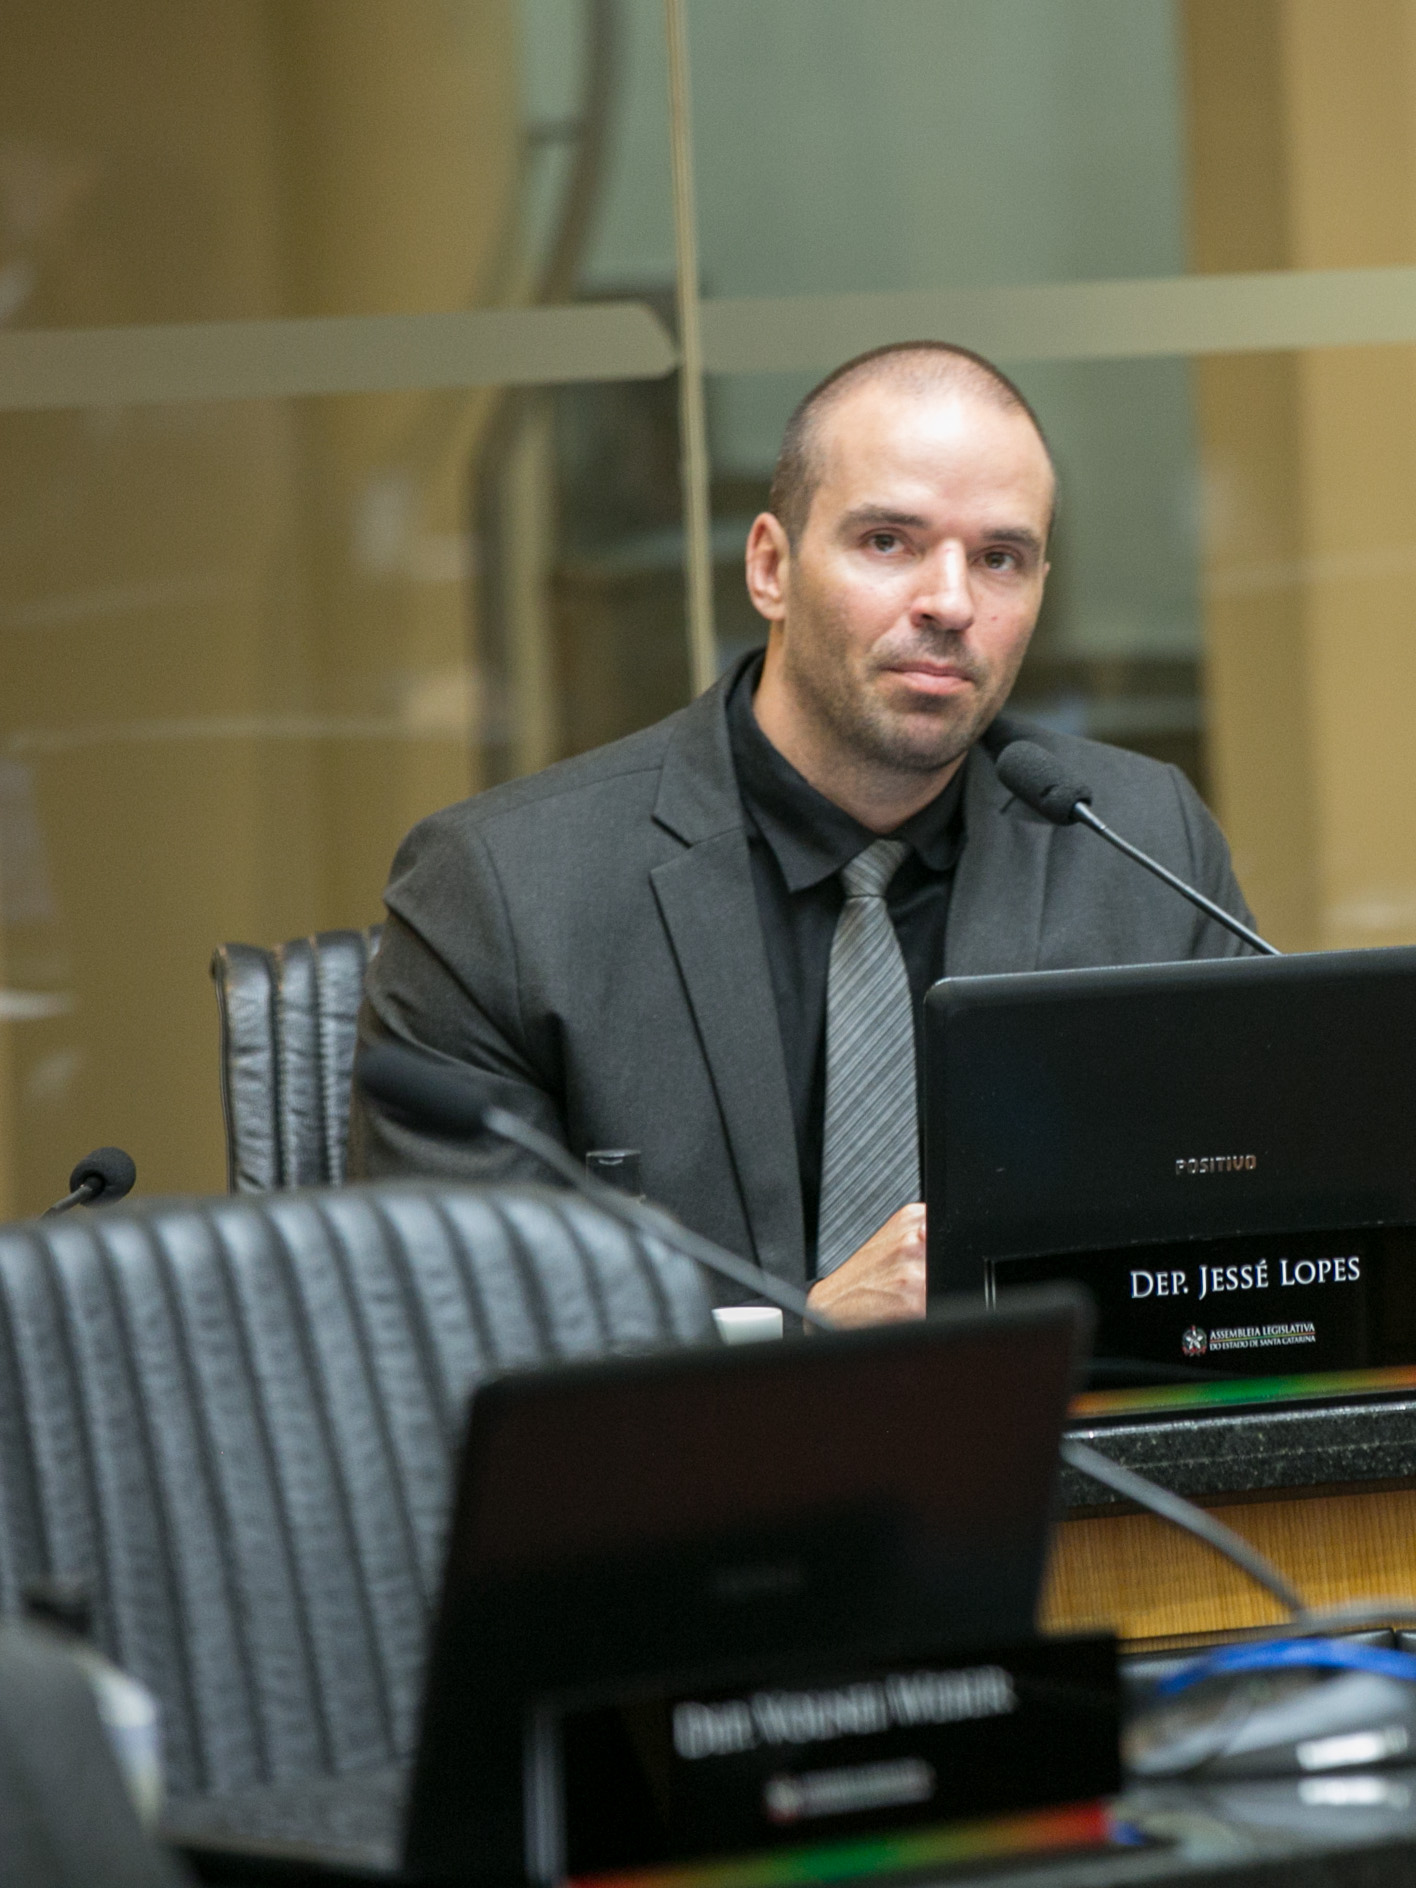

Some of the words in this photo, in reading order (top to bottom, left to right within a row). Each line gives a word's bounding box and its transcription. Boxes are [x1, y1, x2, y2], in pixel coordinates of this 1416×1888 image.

[1175, 1154, 1256, 1175] POSITIVO
[1130, 1271, 1189, 1298] DEP.
[1199, 1259, 1269, 1300] JESSÉ
[1280, 1257, 1360, 1286] LOPES
[1210, 1326, 1260, 1340] ASSEMBLEIA
[1262, 1322, 1315, 1336] LEGISLATIVA
[1209, 1342, 1221, 1351] DO
[1222, 1340, 1249, 1350] ESTADO
[1249, 1339, 1259, 1348] DE
[1260, 1337, 1281, 1347] SANTA
[1282, 1335, 1316, 1345] CATARINA
